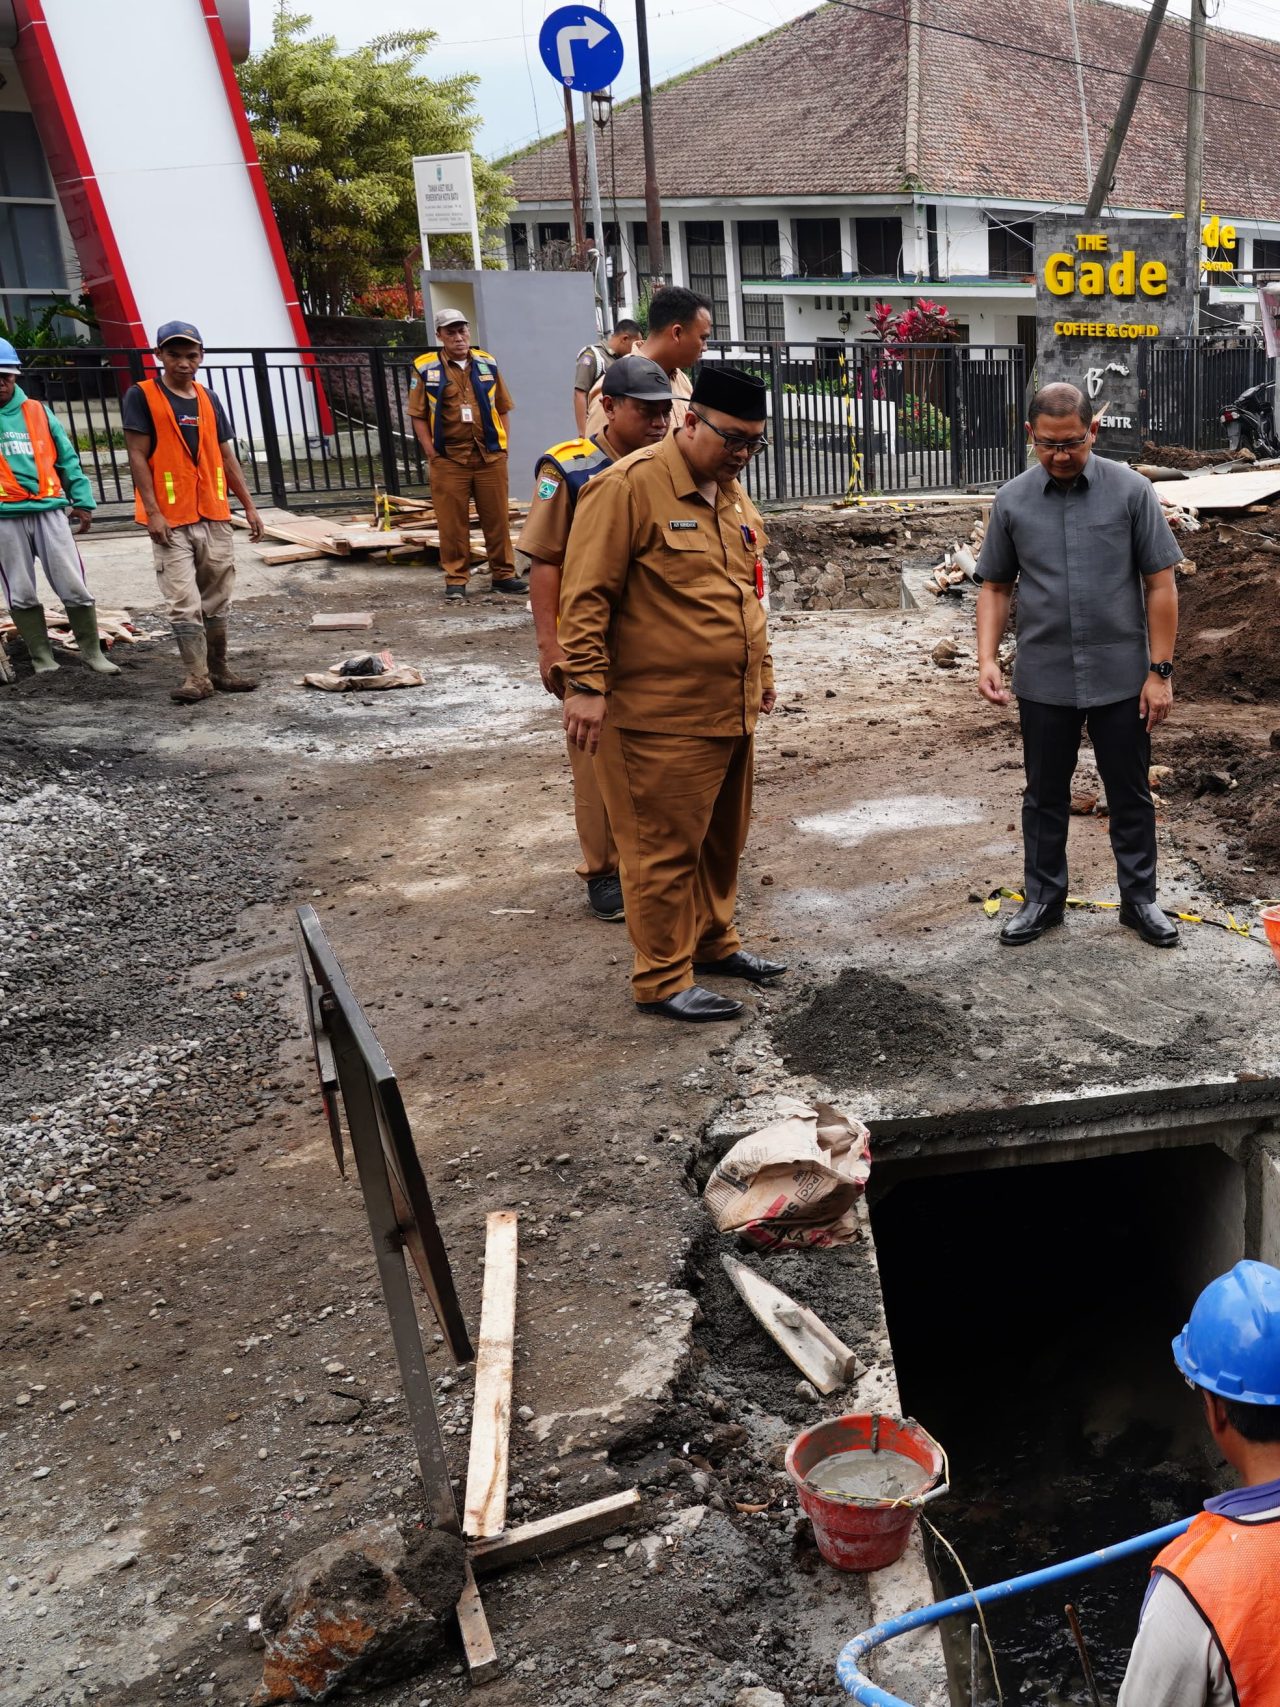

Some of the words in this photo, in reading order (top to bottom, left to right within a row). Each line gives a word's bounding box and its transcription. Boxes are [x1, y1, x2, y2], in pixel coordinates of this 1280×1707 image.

[1075, 234, 1108, 251] THE
[1044, 250, 1168, 297] Gade
[800, 1173, 820, 1197] PCC
